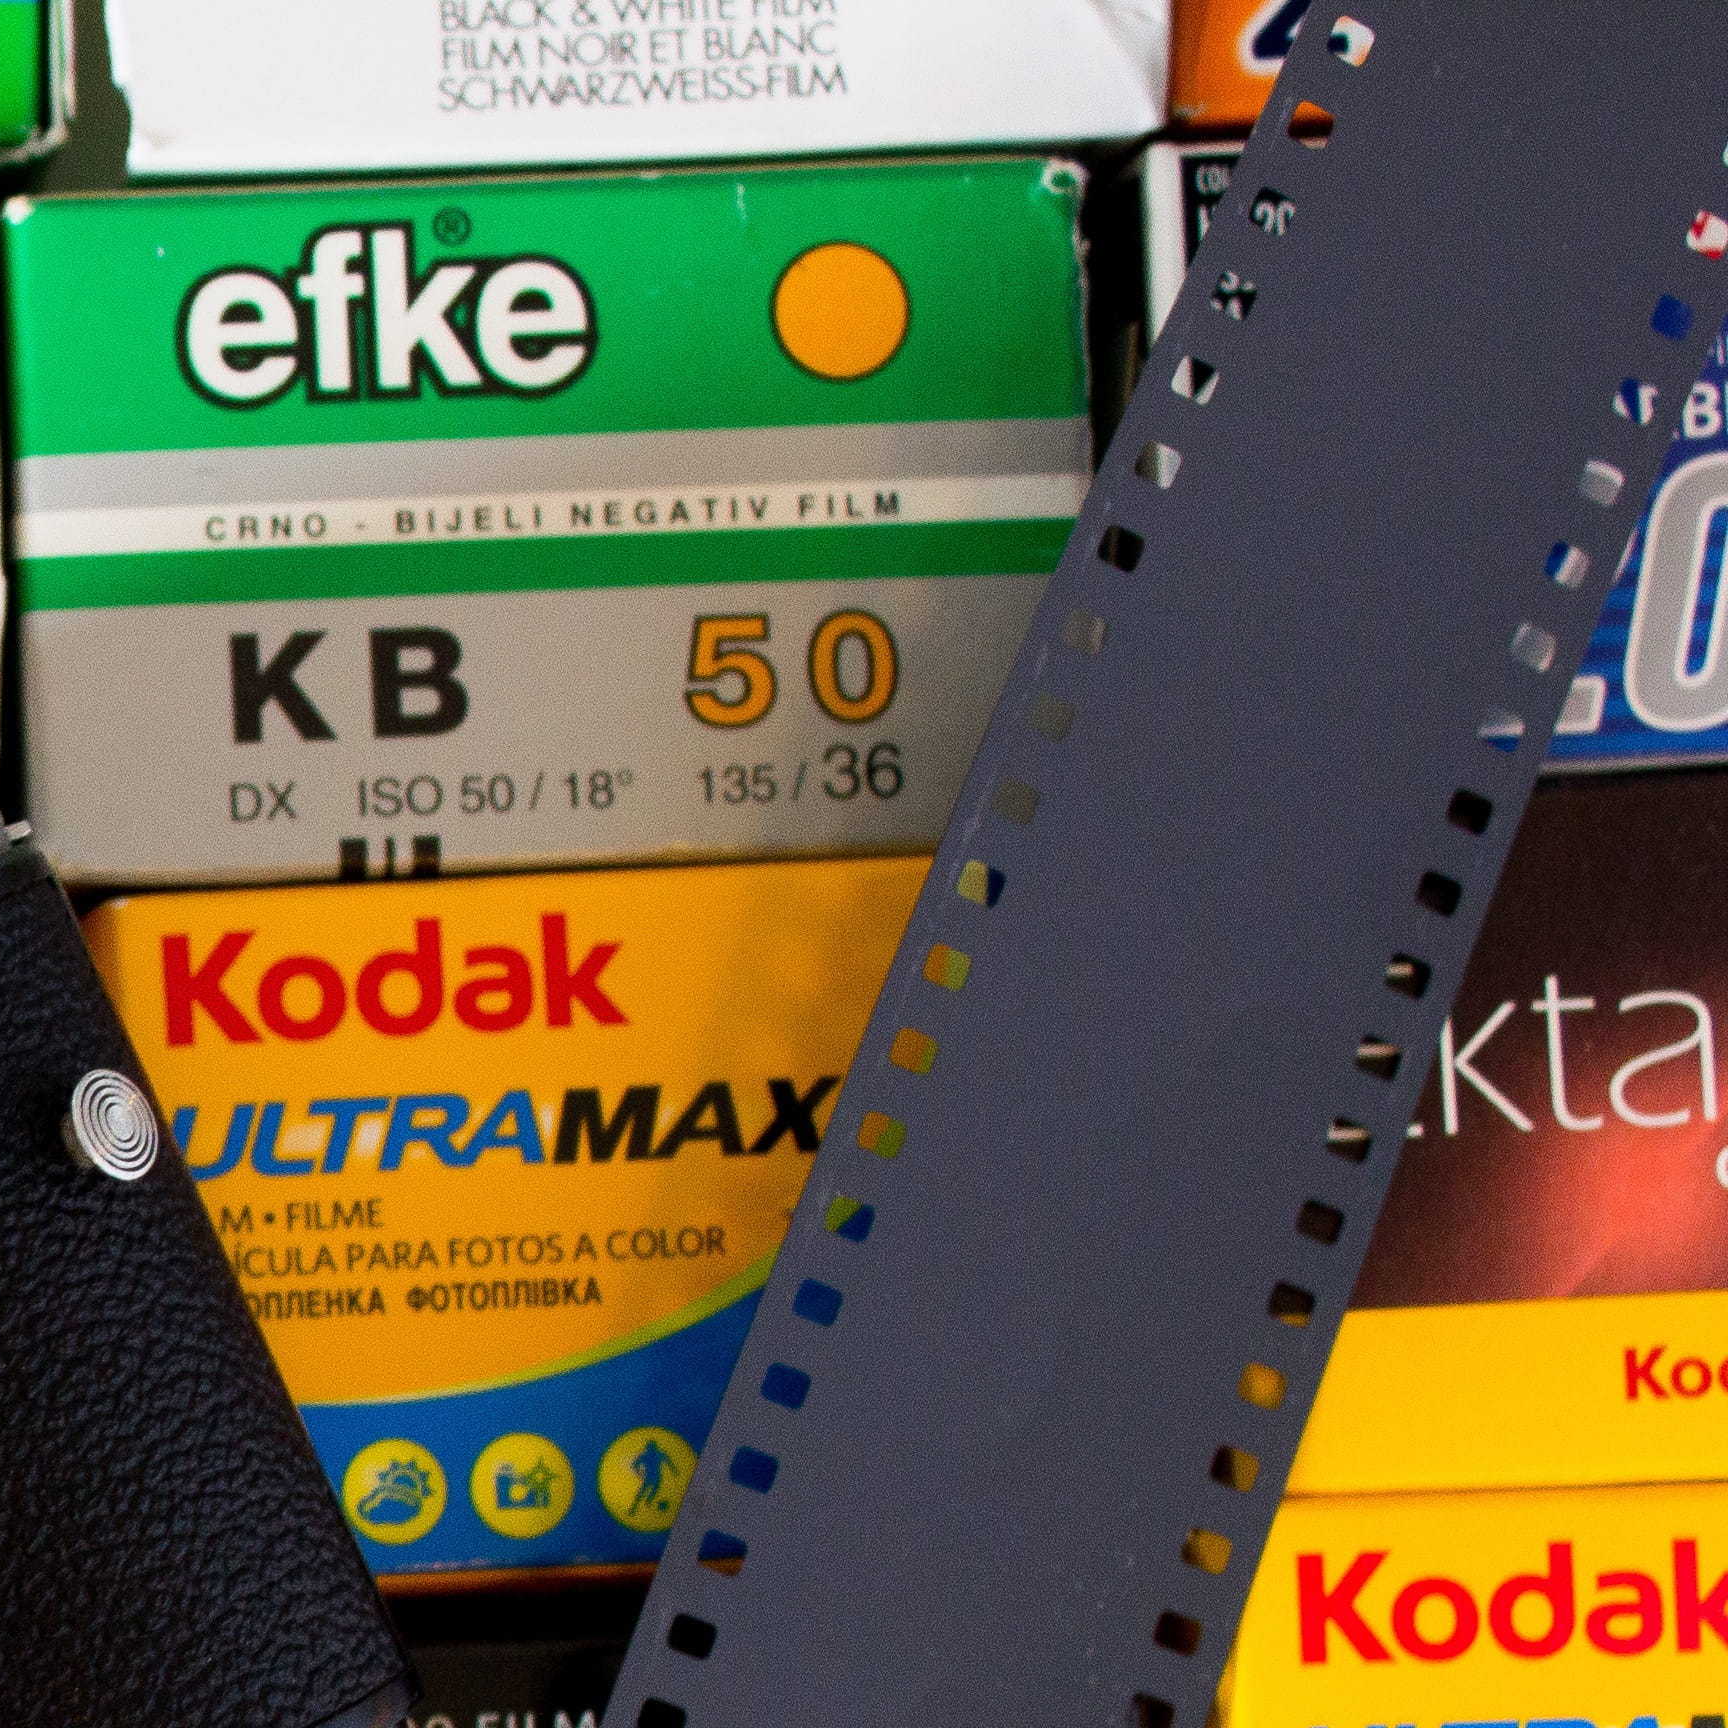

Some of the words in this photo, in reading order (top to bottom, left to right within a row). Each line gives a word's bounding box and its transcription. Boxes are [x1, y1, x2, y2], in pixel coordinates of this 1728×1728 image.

[442, 37, 528, 71] FILM
[538, 31, 638, 67] NOIR
[650, 28, 687, 63] ET
[703, 21, 839, 61] BLANC
[176, 219, 599, 411] efke
[204, 511, 329, 542] CRNO
[393, 503, 543, 535] BIJELI
[569, 496, 769, 528] NEGATIV
[797, 490, 901, 519] FILM
[228, 780, 298, 825] DX
[356, 773, 445, 819] ISO
[159, 910, 631, 1048] Kodak
[172, 1073, 841, 1183] ULTRAMAX
[284, 1198, 384, 1231] FILME
[344, 1240, 440, 1274] PARA
[447, 1231, 564, 1269] FOTOS
[574, 1230, 600, 1264] A
[605, 1225, 728, 1264] COLOR
[1296, 1538, 1728, 1667] Kodak
